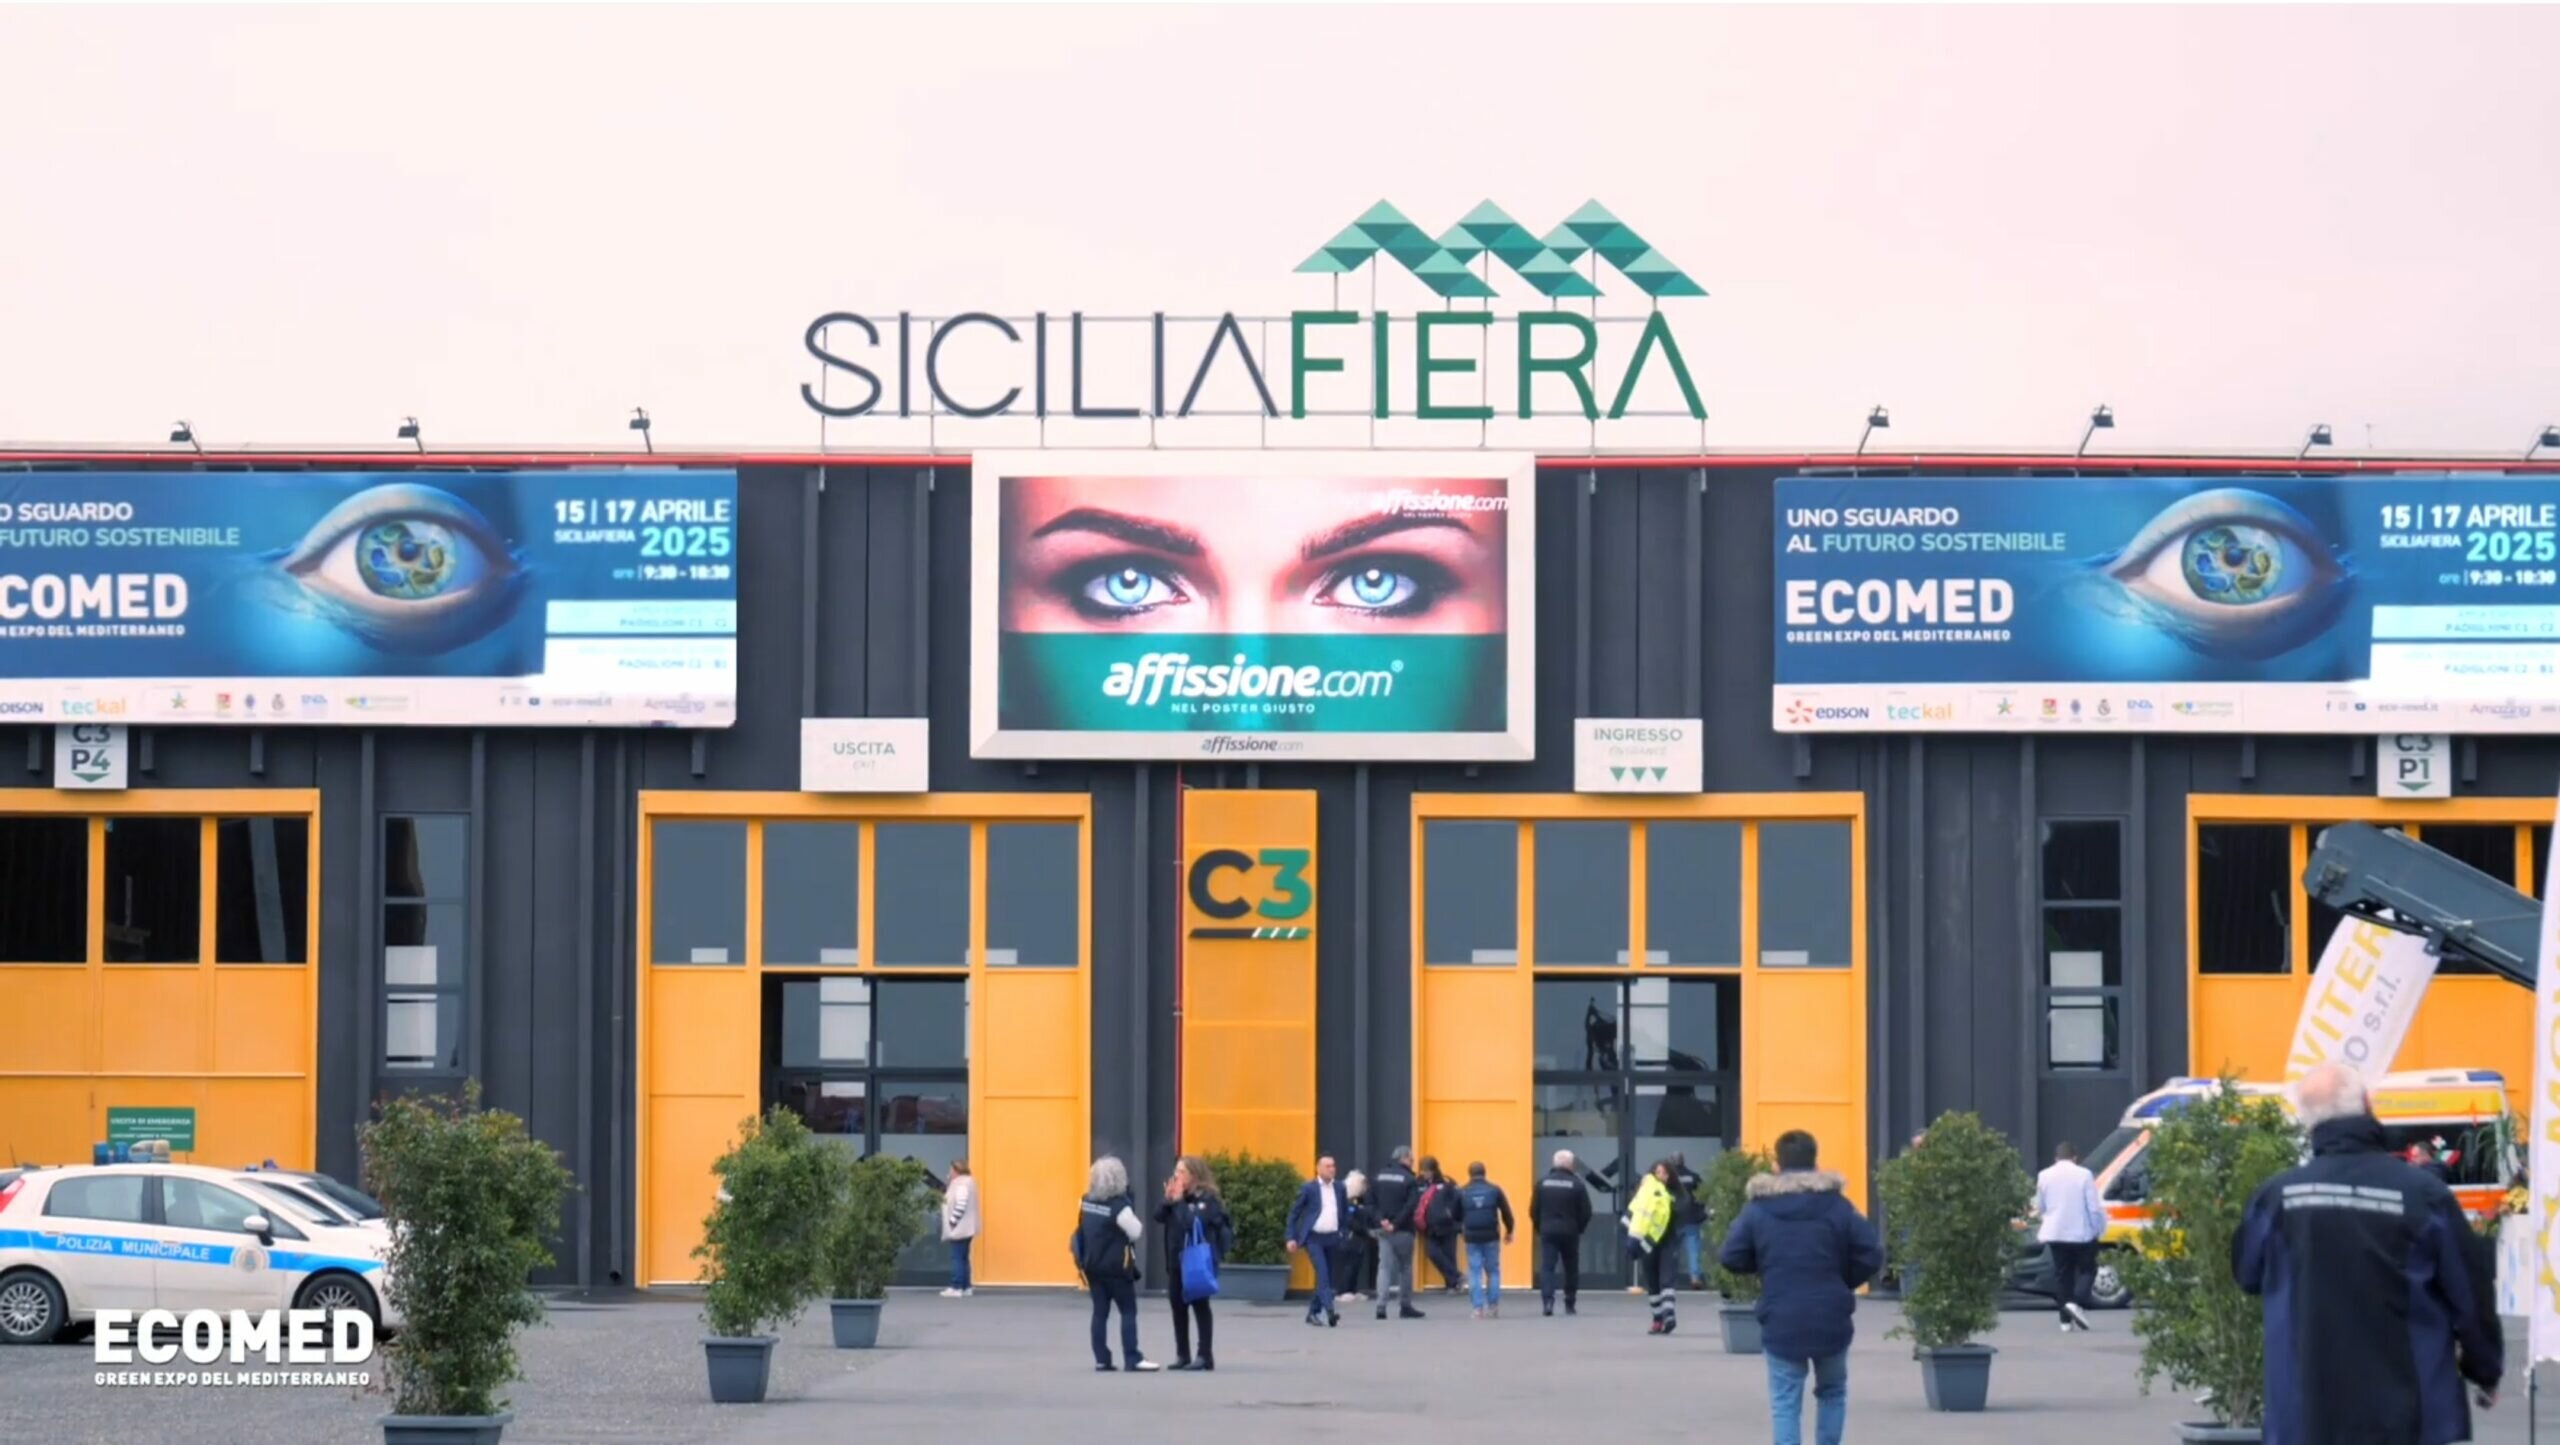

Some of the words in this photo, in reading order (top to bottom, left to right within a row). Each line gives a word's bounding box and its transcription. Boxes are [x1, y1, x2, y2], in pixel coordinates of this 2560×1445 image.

[801, 311, 1708, 419] SICILIAFIERA
[18, 503, 133, 521] SGUARDO
[555, 501, 586, 523] 15
[606, 501, 636, 523] 17
[640, 500, 731, 522] APRILE
[1787, 509, 1838, 526] UNO
[1844, 508, 1959, 526] SGUARDO
[2381, 505, 2411, 528] 15
[2431, 505, 2461, 528] 17
[2466, 505, 2556, 527] APRILE
[0, 528, 90, 546] FUTURO
[96, 528, 240, 546] SOSTENIBILE
[554, 530, 636, 543] SICILIAFIERA
[641, 526, 731, 556] 2025
[1787, 534, 1817, 552] AL
[1823, 533, 1915, 551] FUTURO
[1922, 533, 2066, 551] SOSTENIBILE
[2380, 535, 2462, 548] SICILIAFIERA
[2466, 531, 2556, 561] 2025
[2438, 574, 2460, 584] ore
[1786, 579, 2014, 624] ECOMED
[10, 625, 45, 637] EXPO
[48, 625, 73, 637] DEL
[77, 624, 185, 636] MEDITERRANEO
[1787, 630, 1832, 642] GREEN
[1835, 630, 1870, 641] EXPO
[1874, 630, 1899, 641] DEL
[1903, 629, 2011, 641] MEDITERRANEO
[62, 699, 126, 715] teckal
[1171, 704, 1197, 713] NEL
[1202, 704, 1258, 713] POSTER
[1262, 704, 1316, 713] GIUSTO
[1887, 704, 1952, 719] teckal
[72, 724, 110, 743] C3
[1594, 728, 1683, 741] INGRESSO
[833, 742, 896, 755] USCITA
[1201, 735, 1304, 754] affissione.com
[2395, 734, 2433, 752] C3
[71, 749, 110, 771] P4
[2400, 758, 2429, 780] P1
[1188, 849, 1312, 919] C3
[56, 1235, 113, 1251] POLIZIA
[122, 1241, 210, 1260] MUNICIPALE
